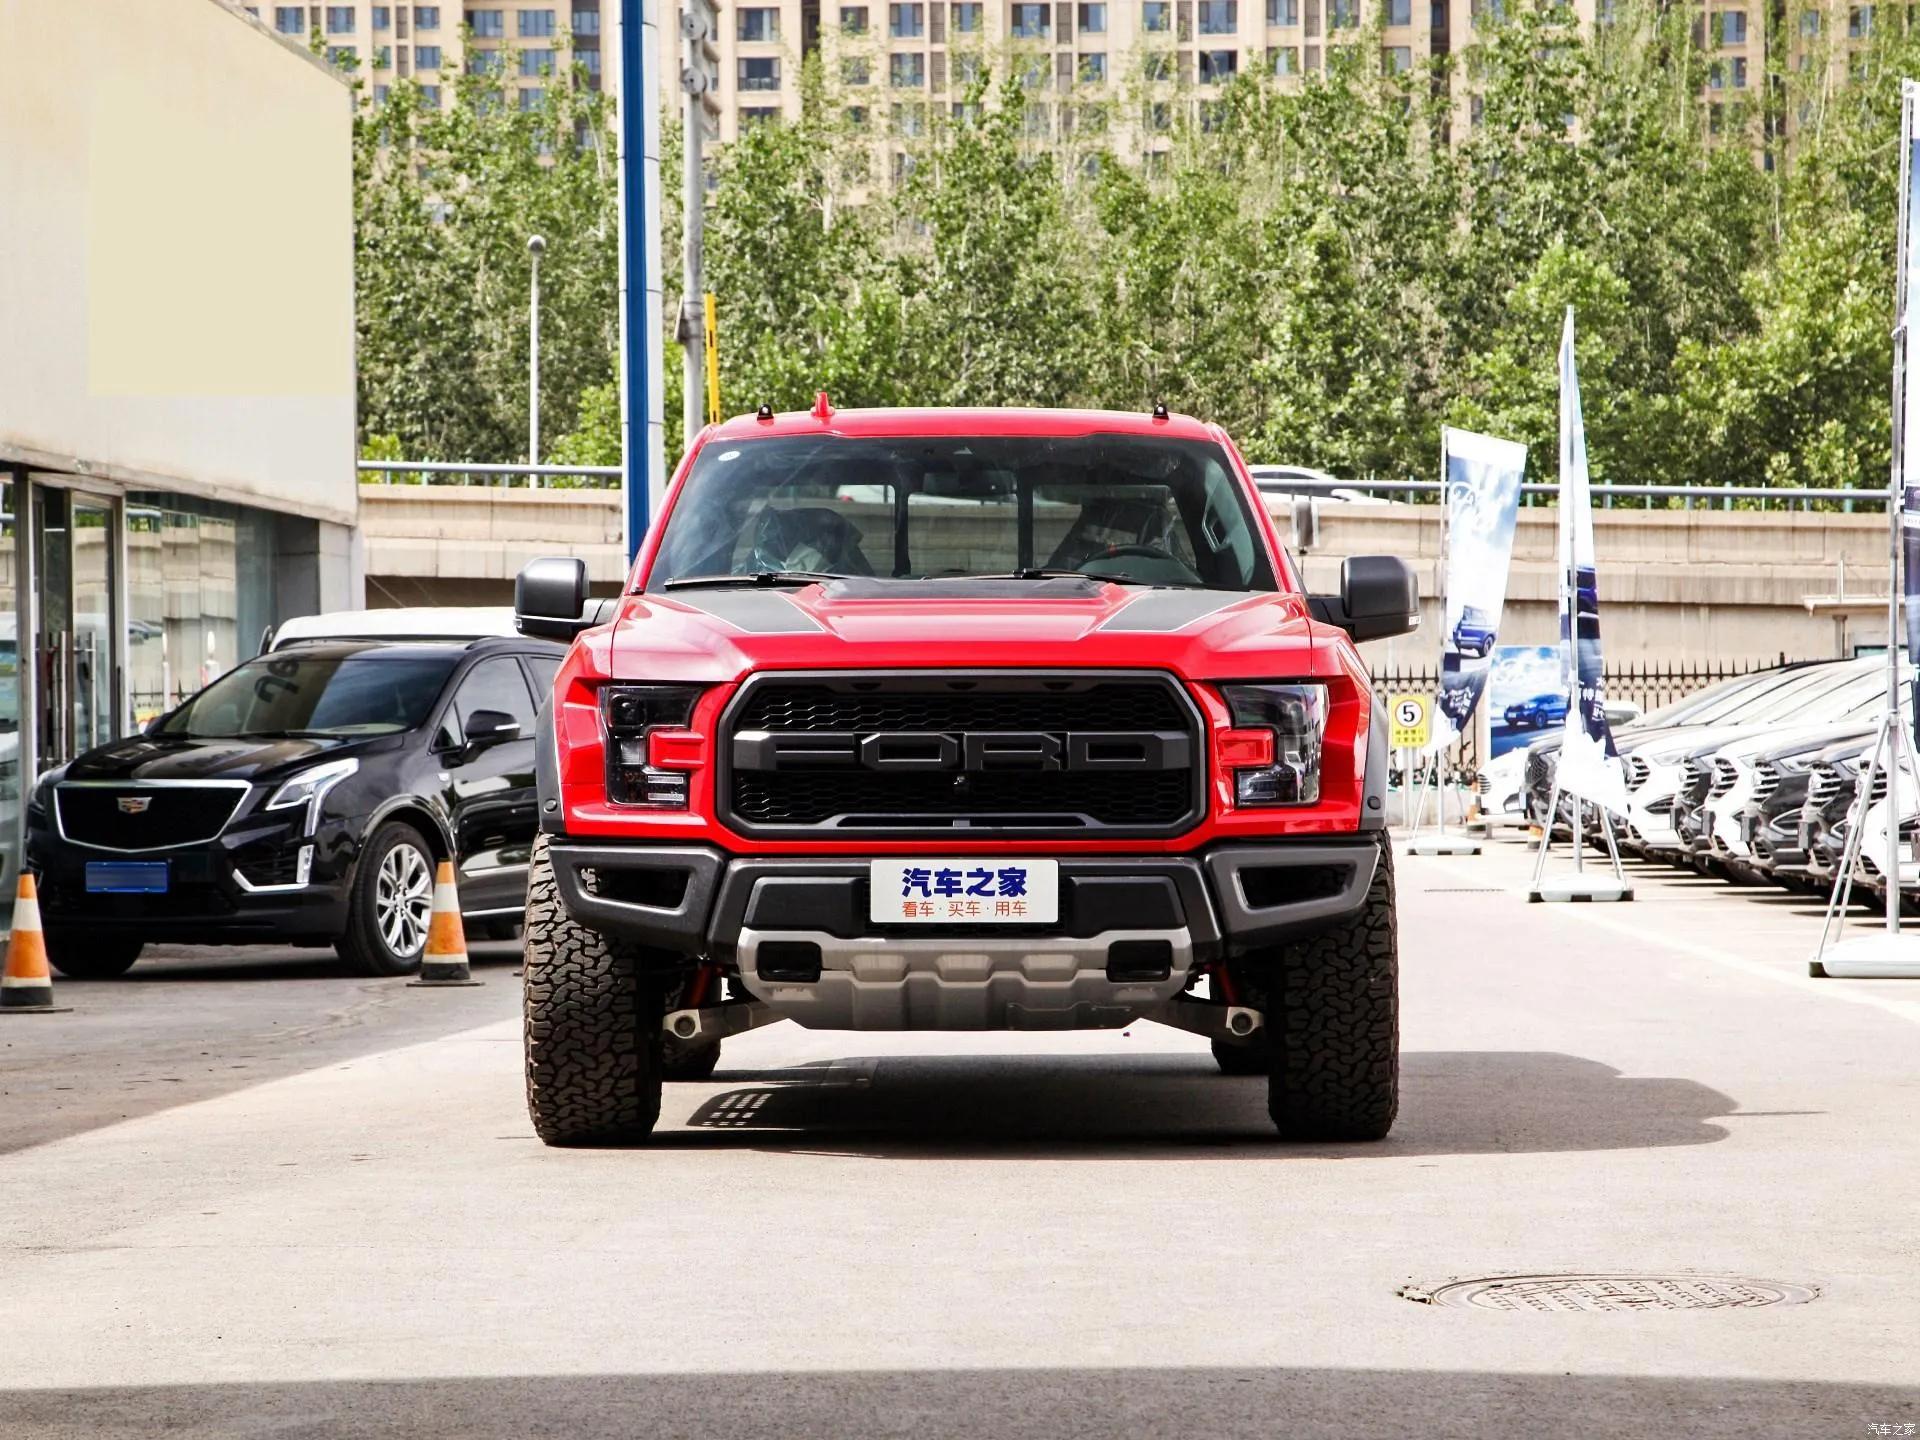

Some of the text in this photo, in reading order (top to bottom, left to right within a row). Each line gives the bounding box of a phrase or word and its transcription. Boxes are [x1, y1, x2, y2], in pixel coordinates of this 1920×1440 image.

[1402, 704, 1415, 723] 5
[750, 730, 1166, 772] FORD
[901, 867, 1028, 898] 汽车之家
